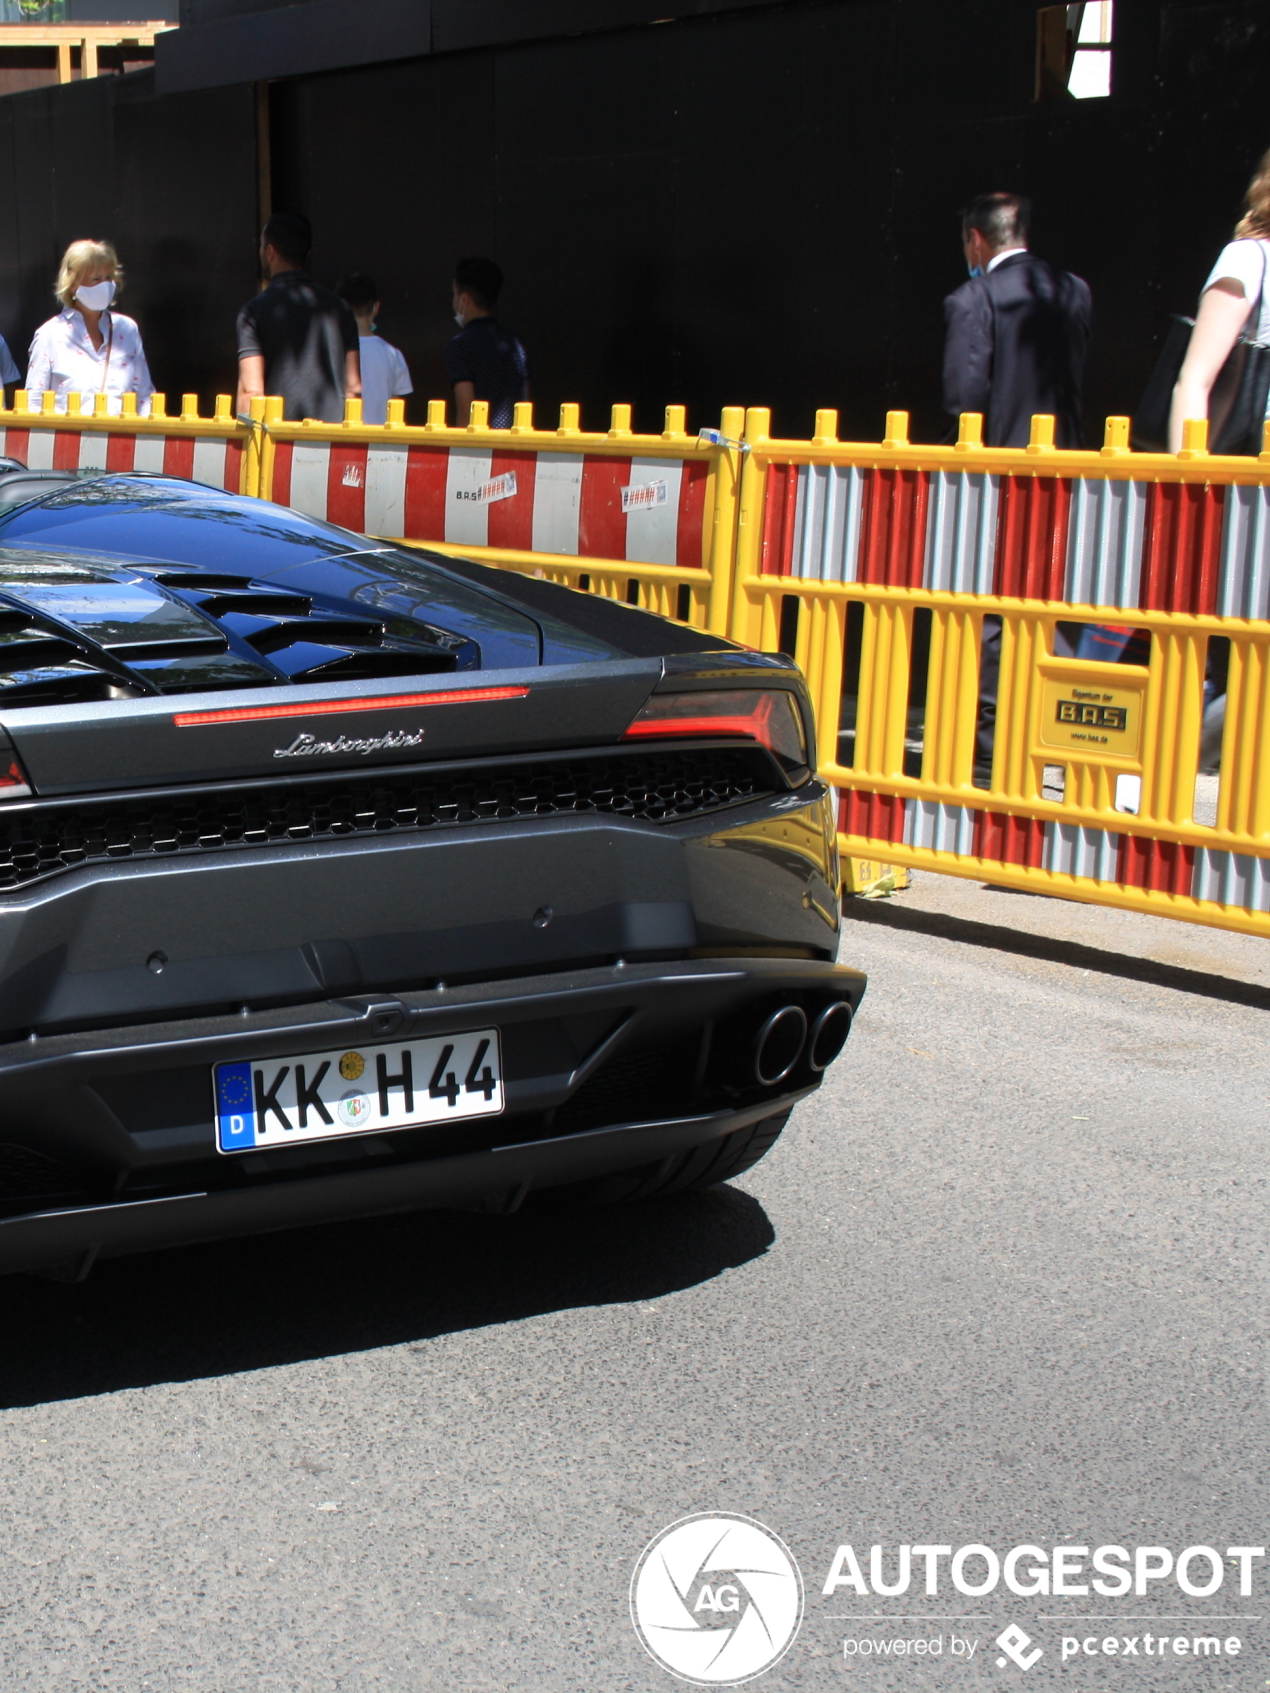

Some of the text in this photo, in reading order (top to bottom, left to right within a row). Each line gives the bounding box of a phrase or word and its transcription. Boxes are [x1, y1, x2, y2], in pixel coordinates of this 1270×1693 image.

[273, 728, 424, 758] Lamborghini
[254, 1061, 334, 1133] KK
[376, 1050, 414, 1116] H
[428, 1039, 496, 1106] 44
[231, 1116, 243, 1134] D
